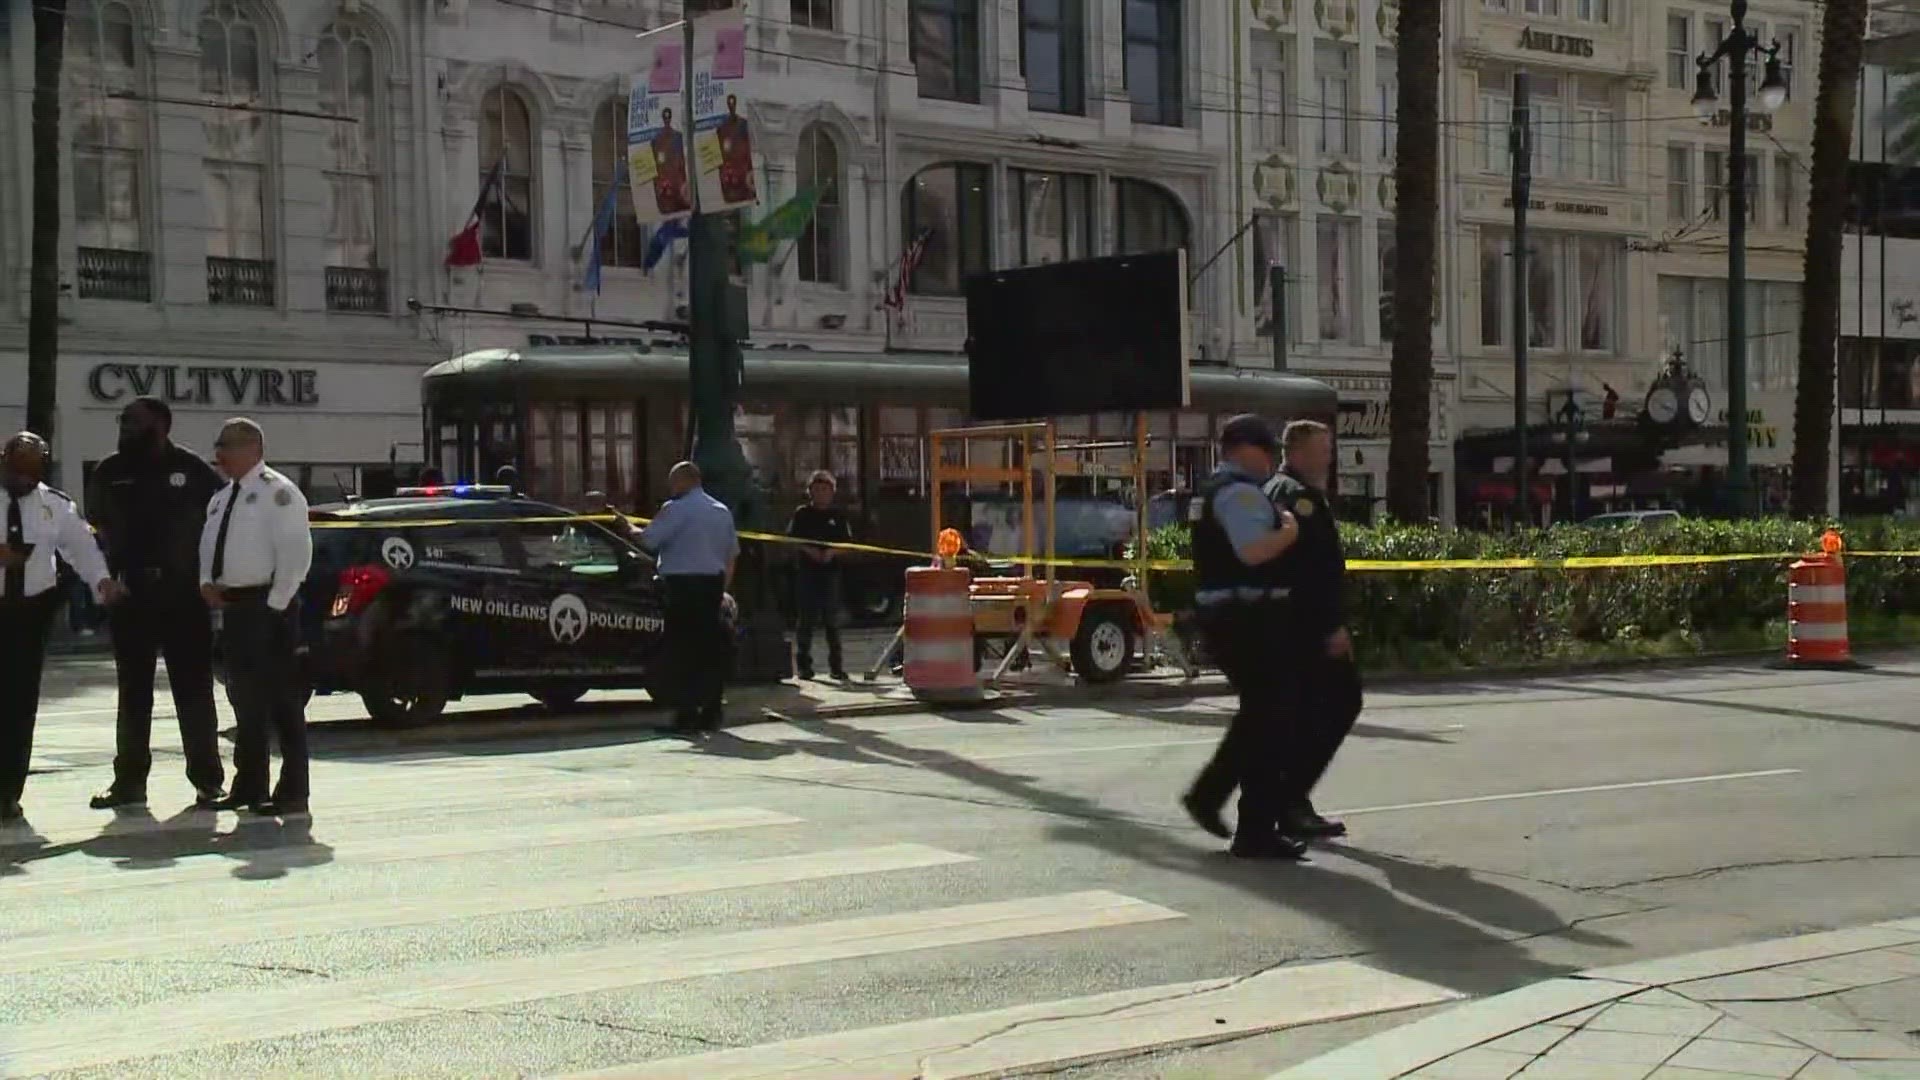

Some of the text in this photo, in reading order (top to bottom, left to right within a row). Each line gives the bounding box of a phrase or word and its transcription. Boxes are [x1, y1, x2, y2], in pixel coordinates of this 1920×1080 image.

[1518, 25, 1593, 58] ADLER'S
[88, 362, 320, 406] CVLTVRE
[450, 595, 482, 615] NEW
[485, 600, 548, 621] ORLEANS
[590, 611, 633, 630] POLICE
